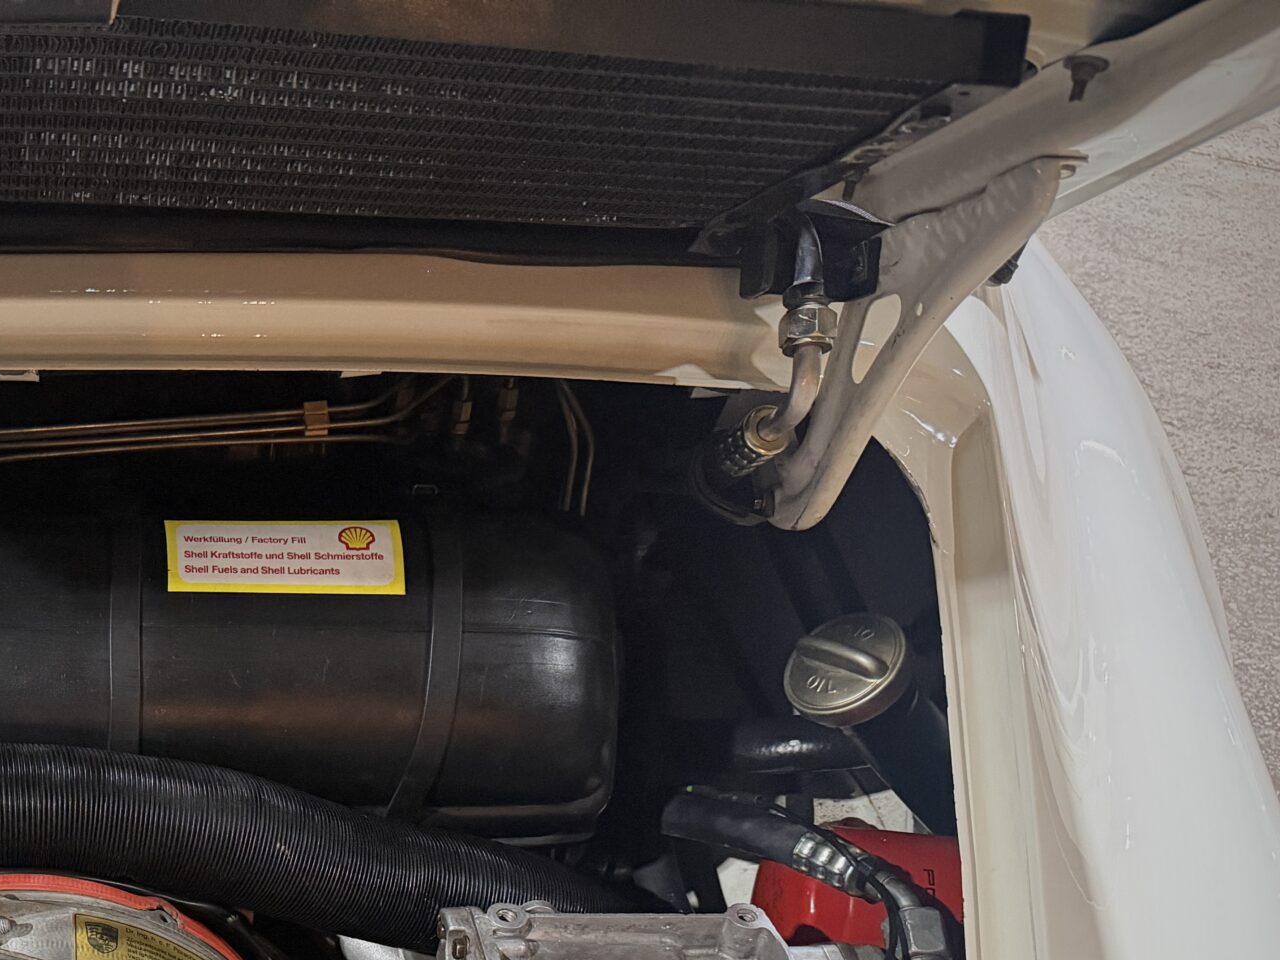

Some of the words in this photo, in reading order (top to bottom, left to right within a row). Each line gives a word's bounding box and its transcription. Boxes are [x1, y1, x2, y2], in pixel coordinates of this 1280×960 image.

[183, 535, 243, 545] Werkfüllung
[244, 536, 249, 544] /
[251, 536, 288, 545] Factory
[291, 536, 306, 544] Fill
[183, 550, 208, 559] Shell
[210, 551, 263, 560] Kraftstoffe
[265, 551, 284, 560] und
[286, 552, 311, 560] Shell
[314, 551, 384, 561] Schmierstoffe
[184, 564, 209, 573] Shell
[211, 565, 238, 574] Fuels
[240, 566, 259, 575] and
[260, 566, 286, 575] Shell
[287, 566, 340, 576] Lubricants
[806, 674, 837, 694] OIL
